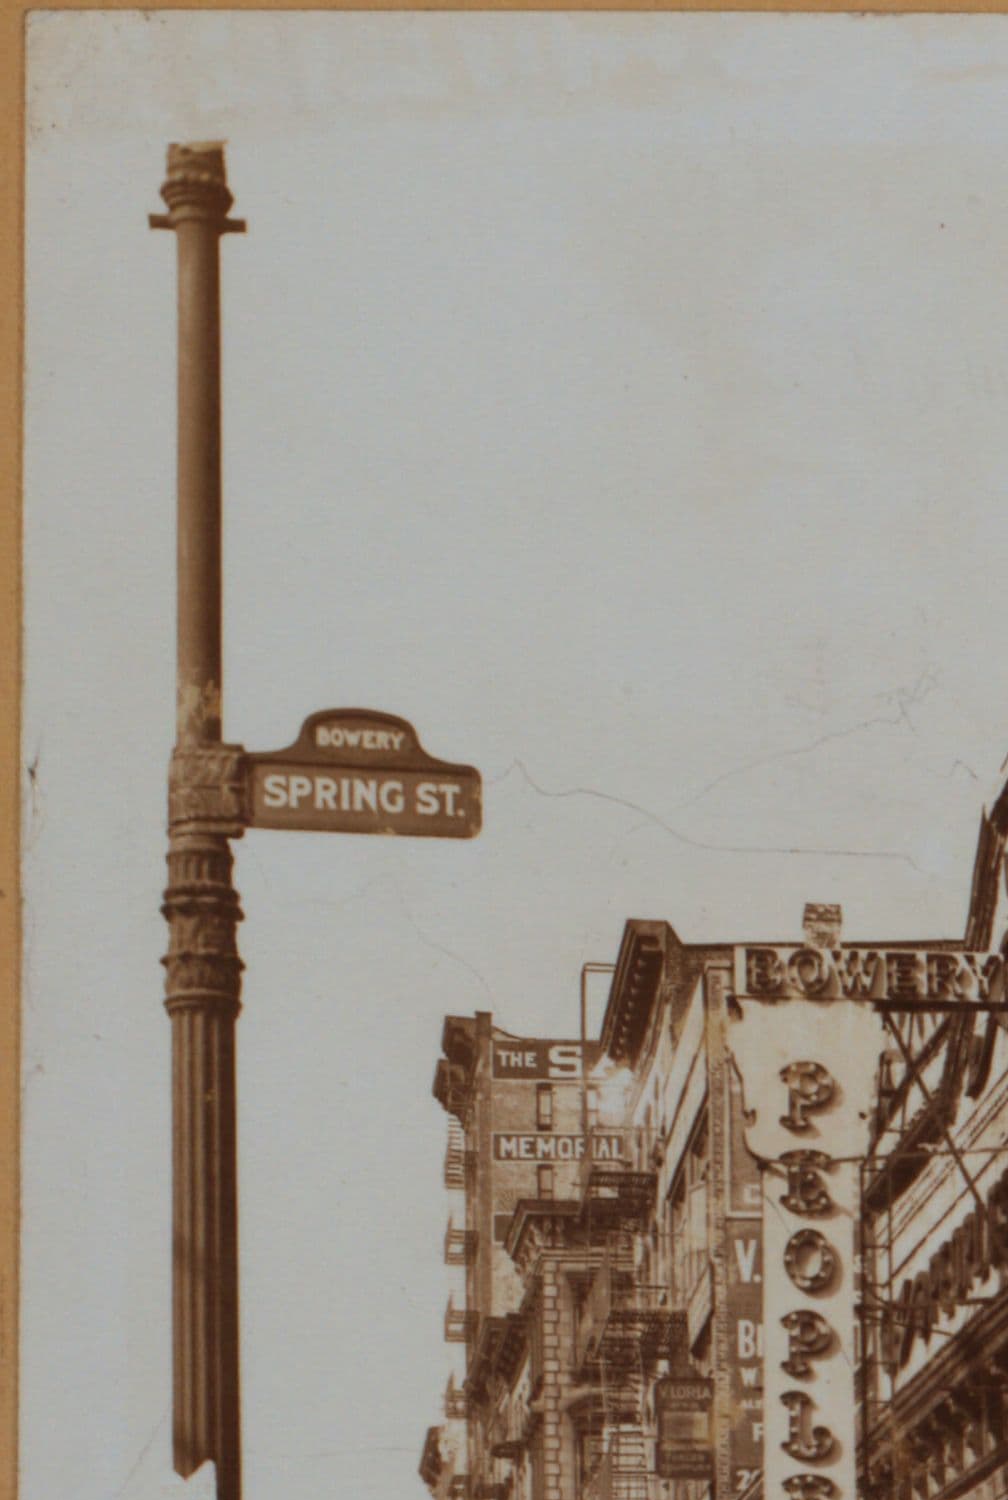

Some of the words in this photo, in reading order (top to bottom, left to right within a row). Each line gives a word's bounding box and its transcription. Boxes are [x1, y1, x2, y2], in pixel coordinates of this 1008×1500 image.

[315, 725, 405, 750] BOWERY
[263, 775, 405, 813] SPRING
[416, 783, 466, 817] ST.
[745, 949, 1002, 1001] BOWERY
[496, 1049, 537, 1068] THE
[500, 1136, 625, 1159] MEMORIAL
